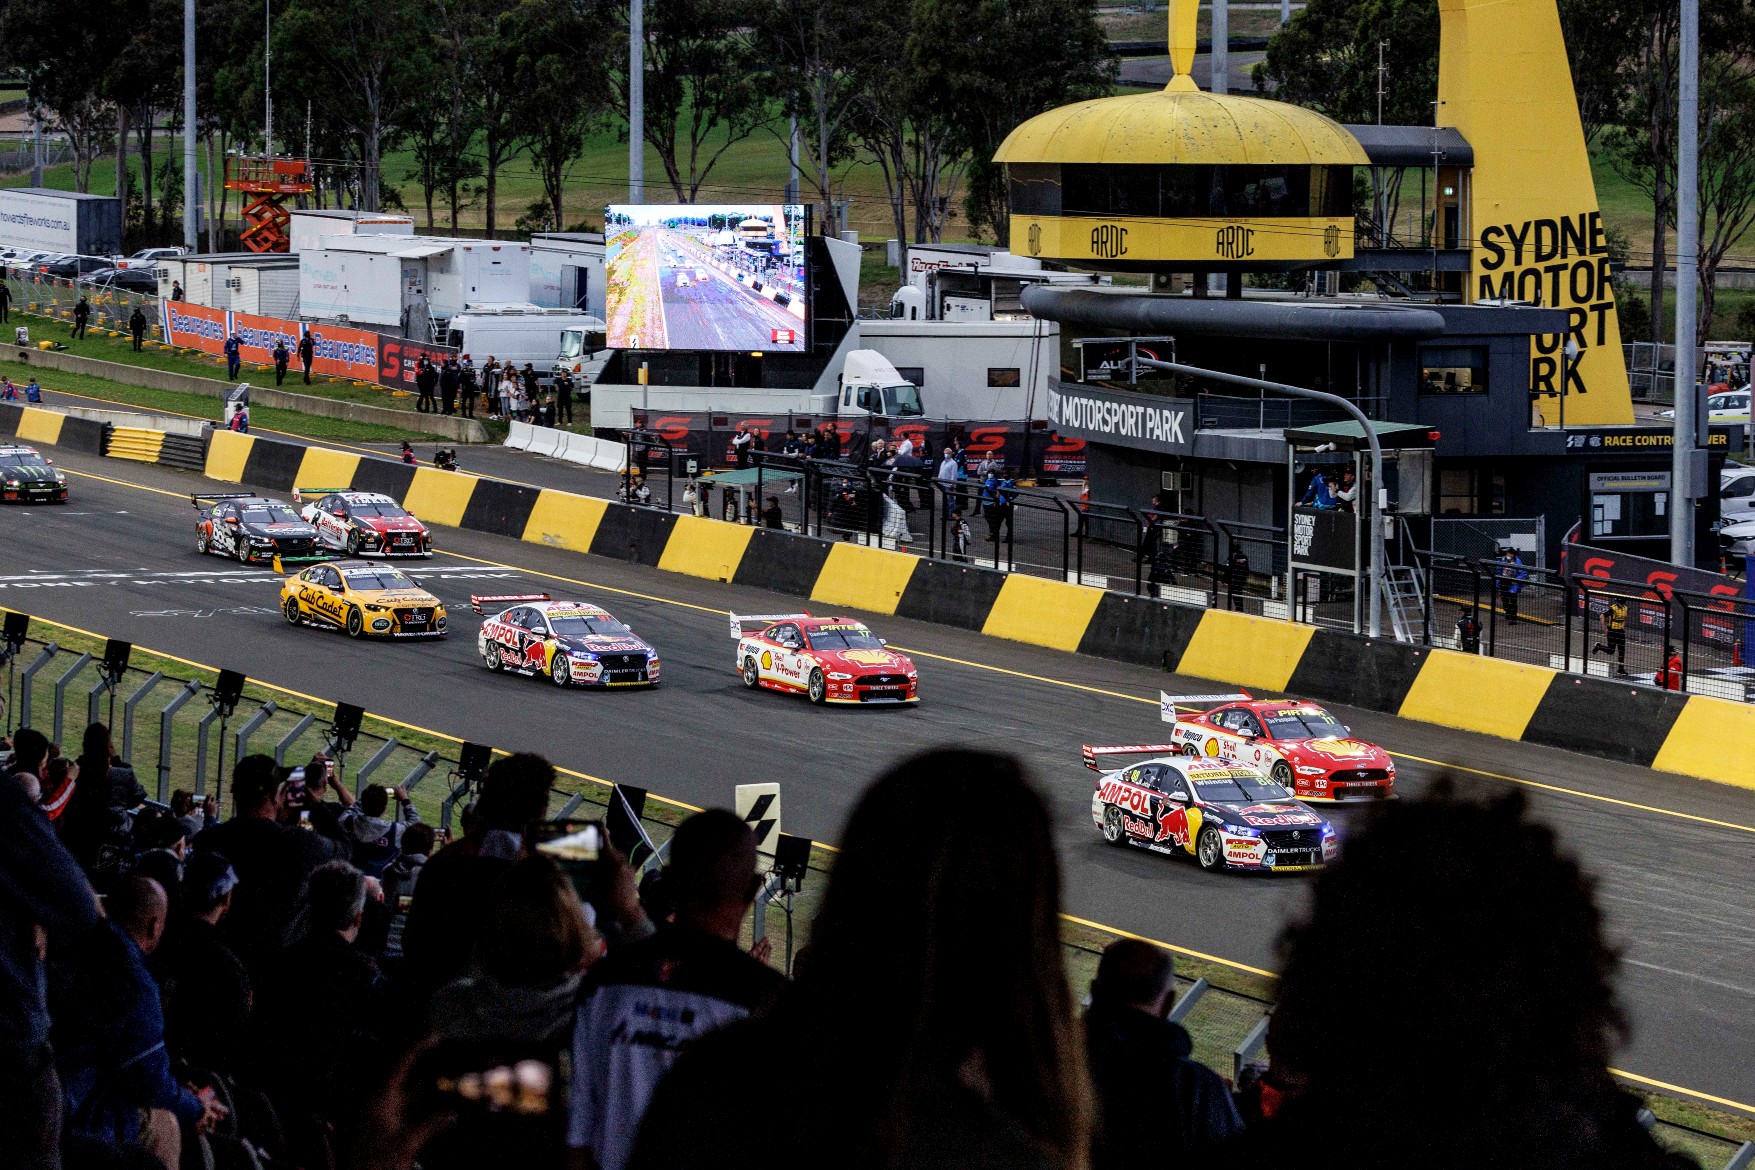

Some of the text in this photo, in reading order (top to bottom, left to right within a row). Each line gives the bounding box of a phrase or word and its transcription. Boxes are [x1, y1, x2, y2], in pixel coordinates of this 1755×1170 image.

[1091, 224, 1128, 258] ARDC
[1216, 225, 1254, 259] ARDC
[171, 308, 225, 344] Beaurepaires
[313, 332, 377, 369] Beaurepaires
[1062, 395, 1145, 438] MOTORSPORT
[1146, 407, 1185, 444] PARK
[1604, 435, 1634, 447] RACE
[1621, 474, 1647, 482] BULLETIN
[1294, 513, 1316, 527] SYDNEY
[1294, 524, 1314, 537] MOTOR
[1294, 534, 1313, 547] SPORT
[1294, 544, 1309, 556] PARK
[299, 586, 344, 620] Cub Cadet
[482, 622, 519, 648] AMPOL
[744, 643, 760, 655] Repco
[572, 670, 598, 678] AMPOL
[774, 661, 801, 680] V-Power
[1183, 729, 1204, 742] Repco
[1223, 740, 1236, 752] Shell
[1195, 778, 1234, 786] Whincup
[1098, 781, 1149, 815] AMPOL
[1227, 850, 1261, 860] AMPOL
